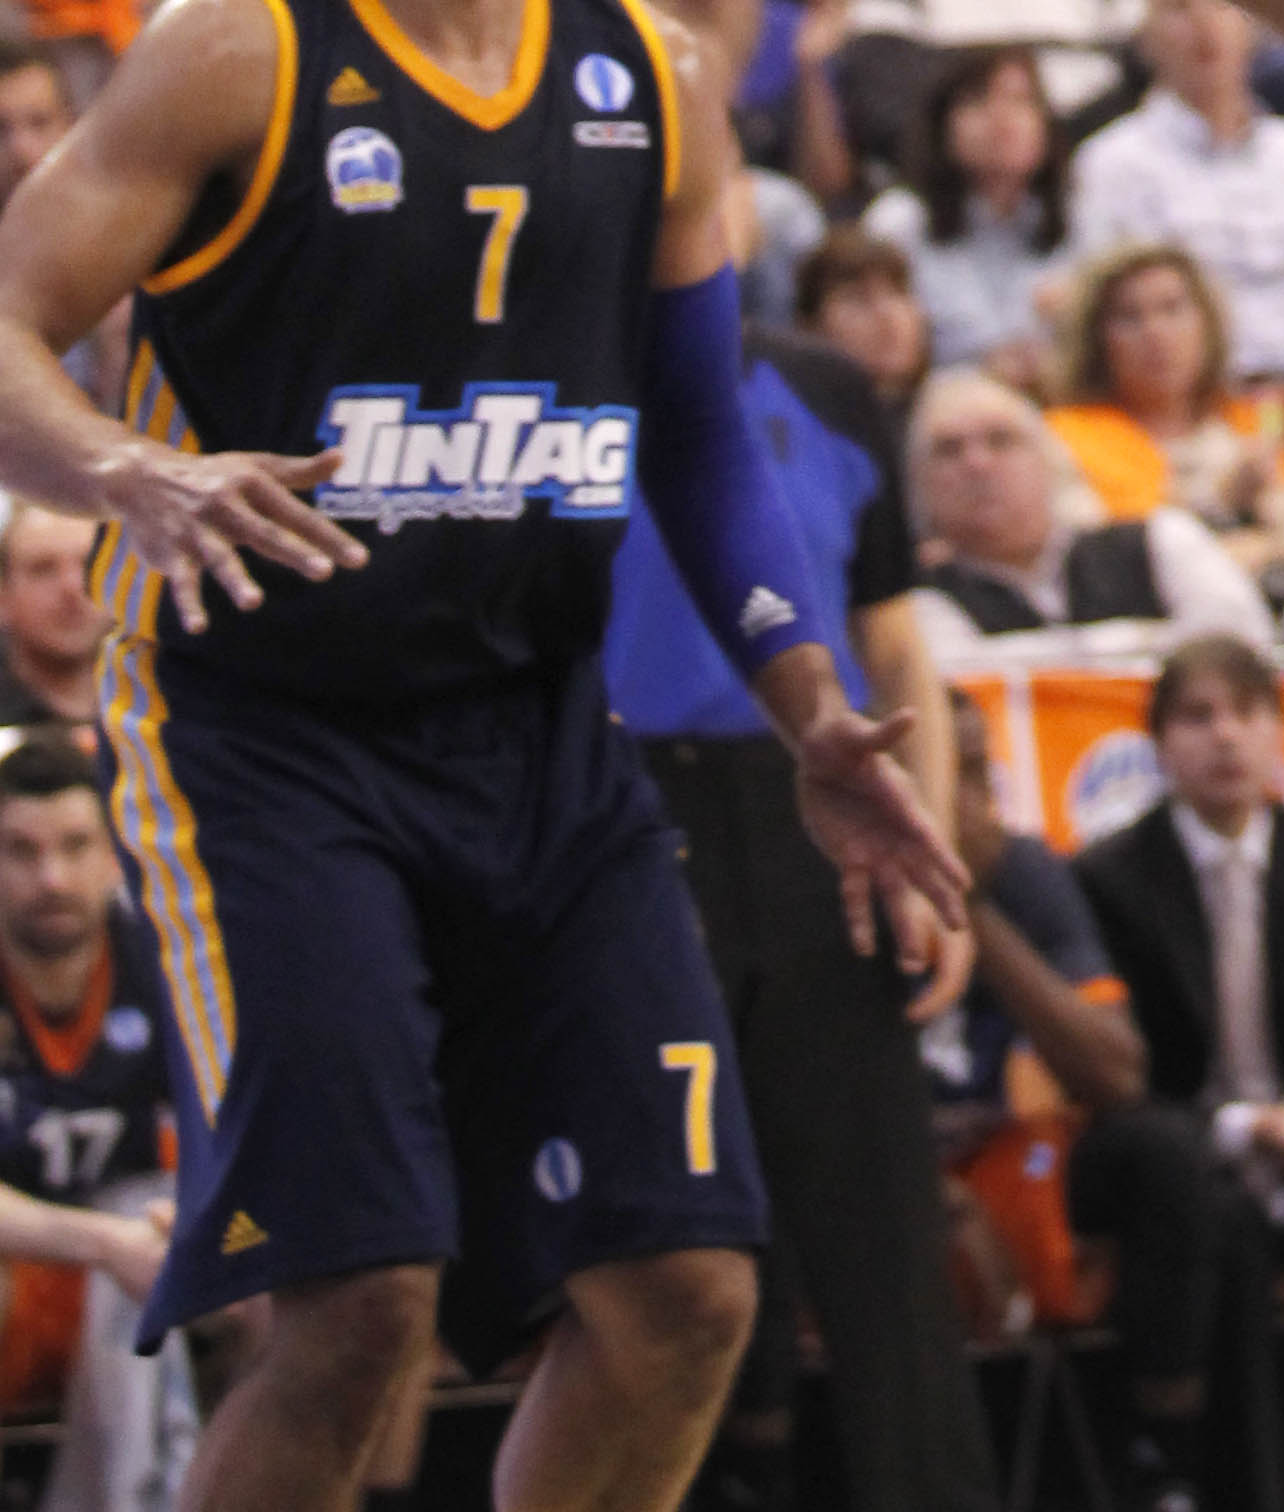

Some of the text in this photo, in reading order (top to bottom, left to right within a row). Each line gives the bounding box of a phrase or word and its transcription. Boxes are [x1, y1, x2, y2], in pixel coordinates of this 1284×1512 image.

[464, 184, 530, 323] 7
[27, 1107, 124, 1185] 17
[657, 1040, 717, 1176] 7
